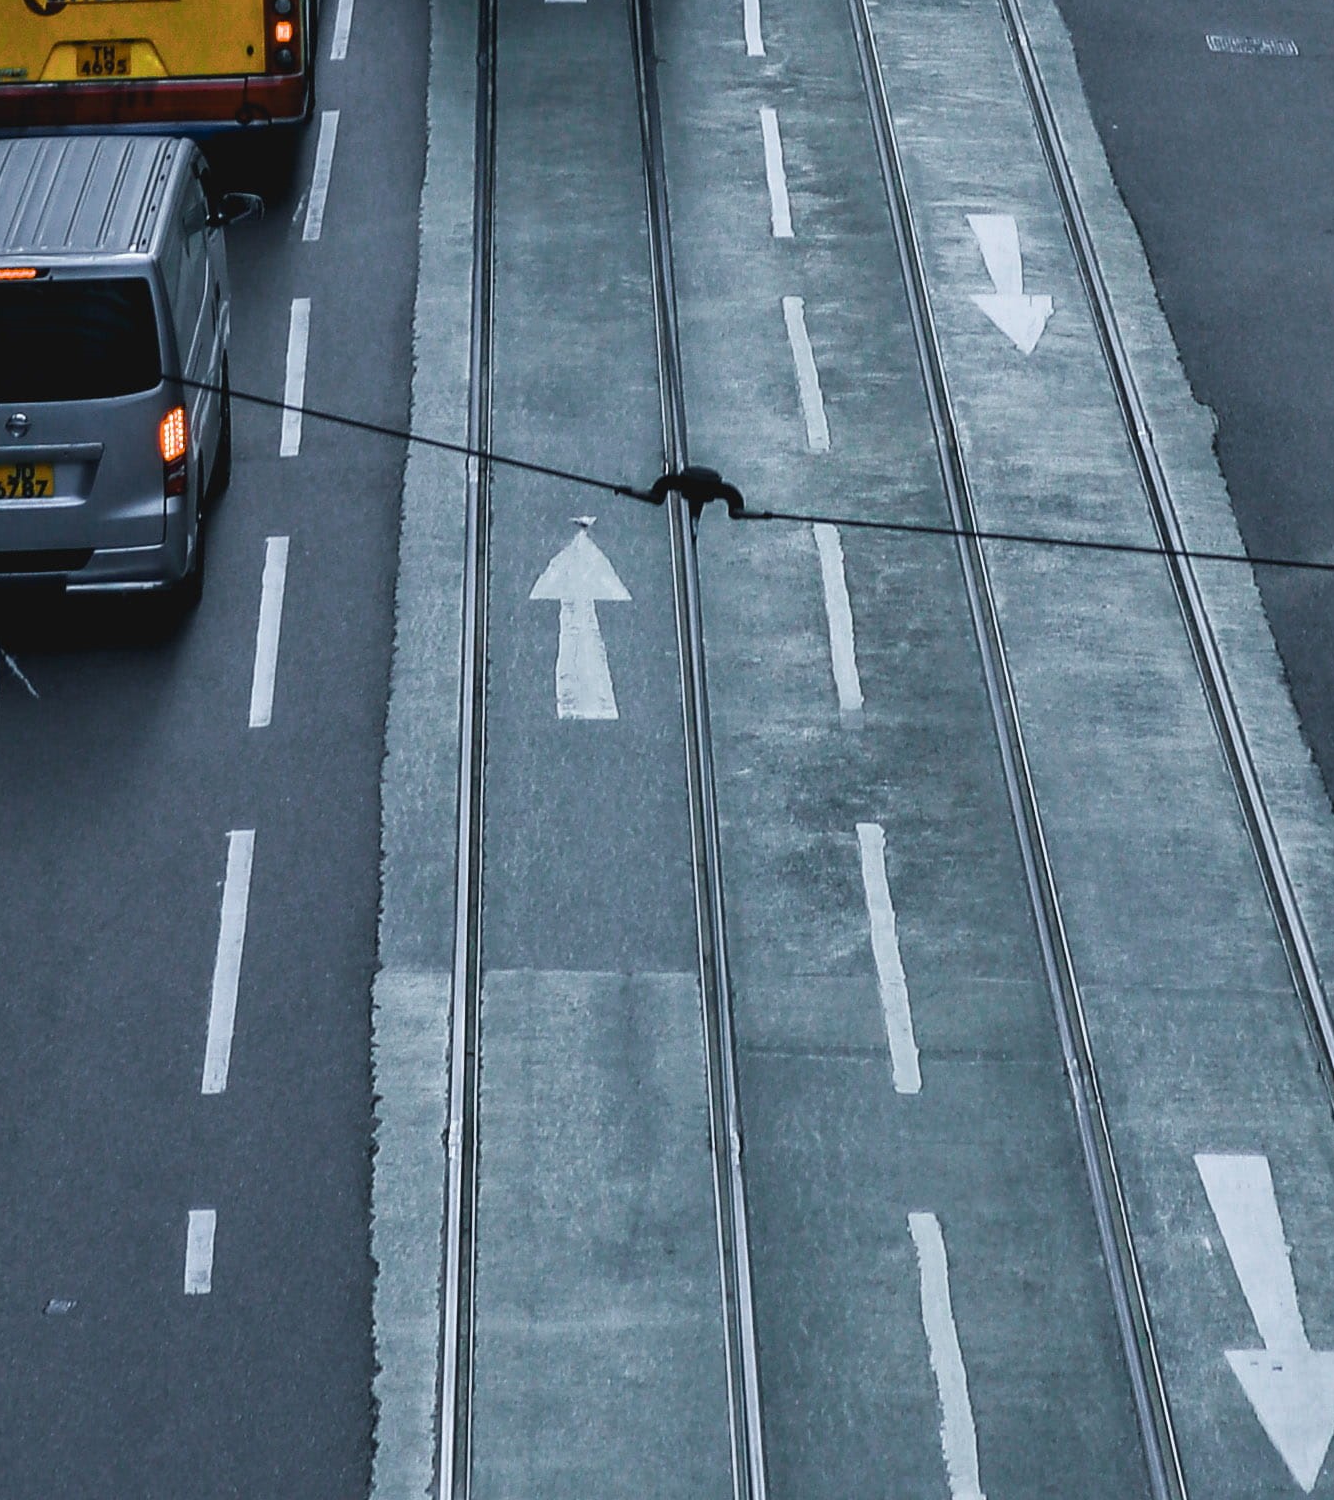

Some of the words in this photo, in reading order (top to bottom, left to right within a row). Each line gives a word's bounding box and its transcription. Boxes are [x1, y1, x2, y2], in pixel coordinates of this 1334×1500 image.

[93, 45, 116, 60] TH
[81, 59, 128, 75] 4695
[11, 463, 36, 480] JD
